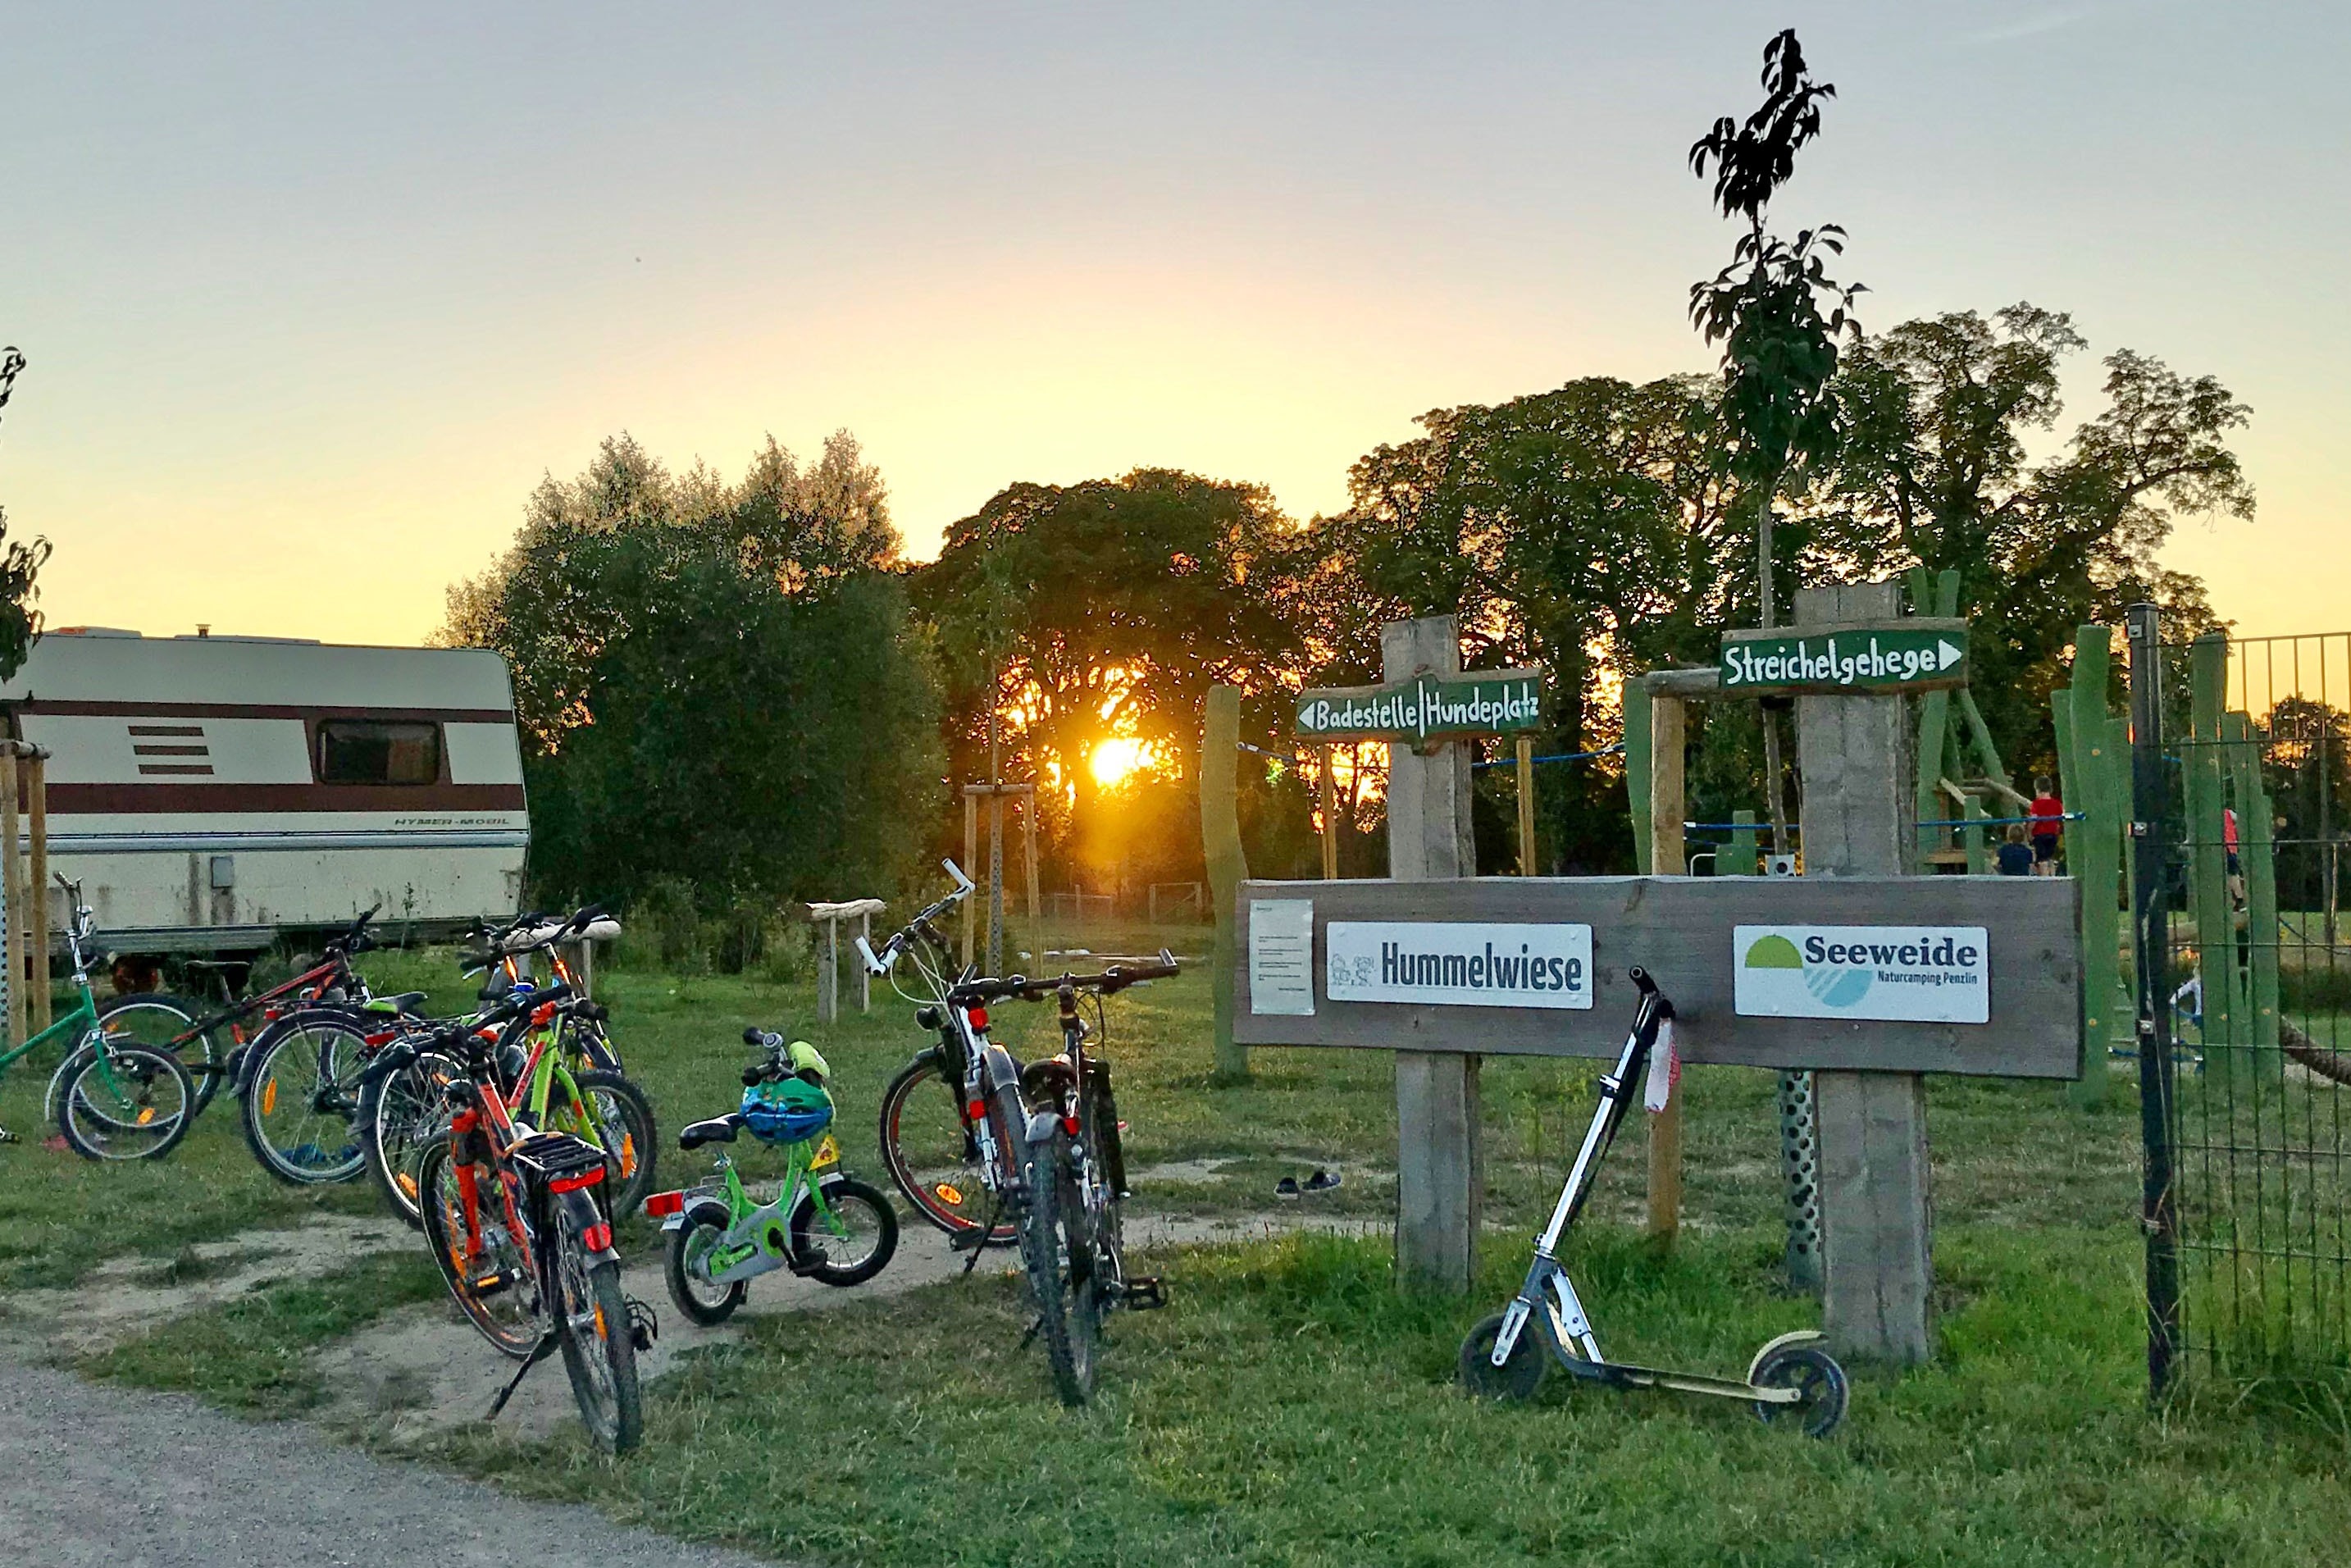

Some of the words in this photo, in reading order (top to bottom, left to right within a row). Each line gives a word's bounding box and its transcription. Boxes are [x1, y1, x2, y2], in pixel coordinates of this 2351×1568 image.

[1725, 637, 1936, 685] Streichelgehege
[1316, 695, 1417, 730] Badestelle
[1425, 681, 1539, 730] Hundeplatz
[1381, 941, 1582, 991] Hummelwiese
[1805, 936, 1978, 967] Seeweide
[1877, 970, 1941, 987] Naturcamping
[1943, 972, 1977, 985] Penzlin
